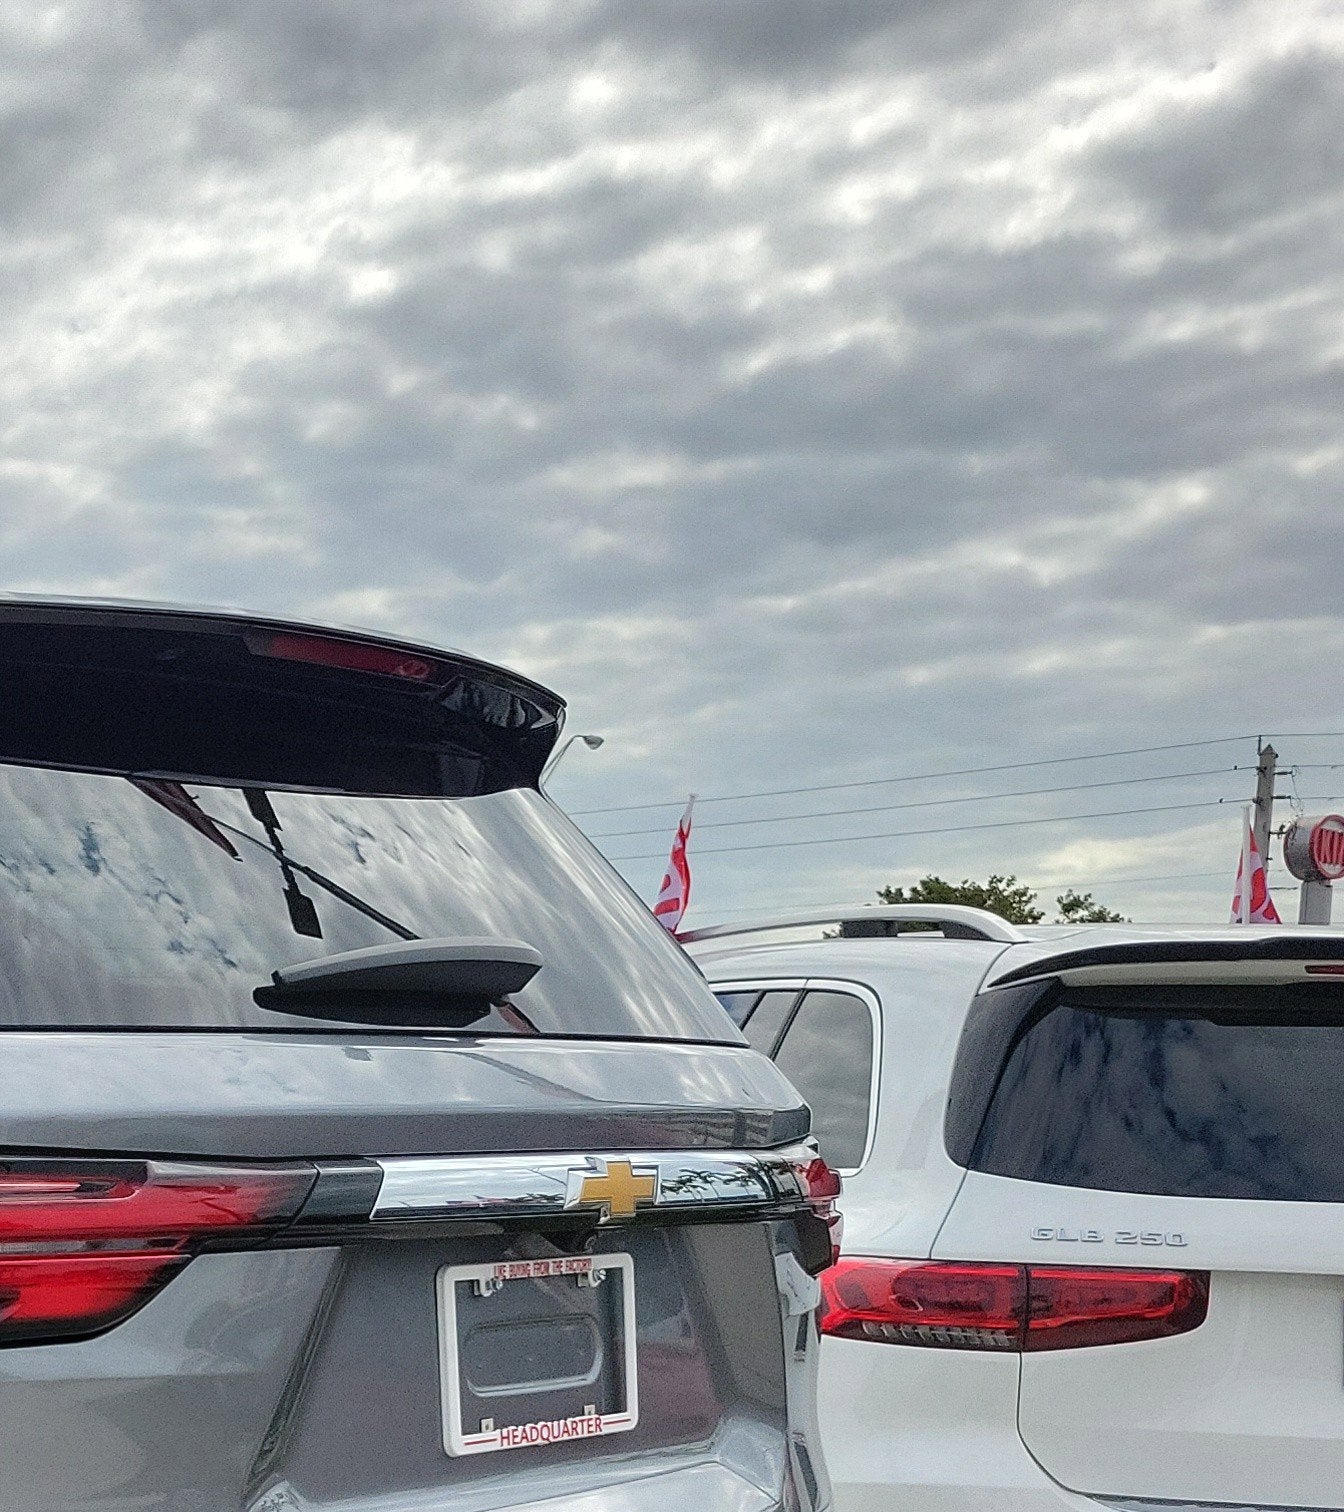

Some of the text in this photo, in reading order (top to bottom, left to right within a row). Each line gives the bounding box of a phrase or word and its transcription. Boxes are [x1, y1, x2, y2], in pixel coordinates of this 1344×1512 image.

[1030, 1227, 1188, 1246] GLB 250
[499, 1417, 604, 1447] HEADQUARTER
